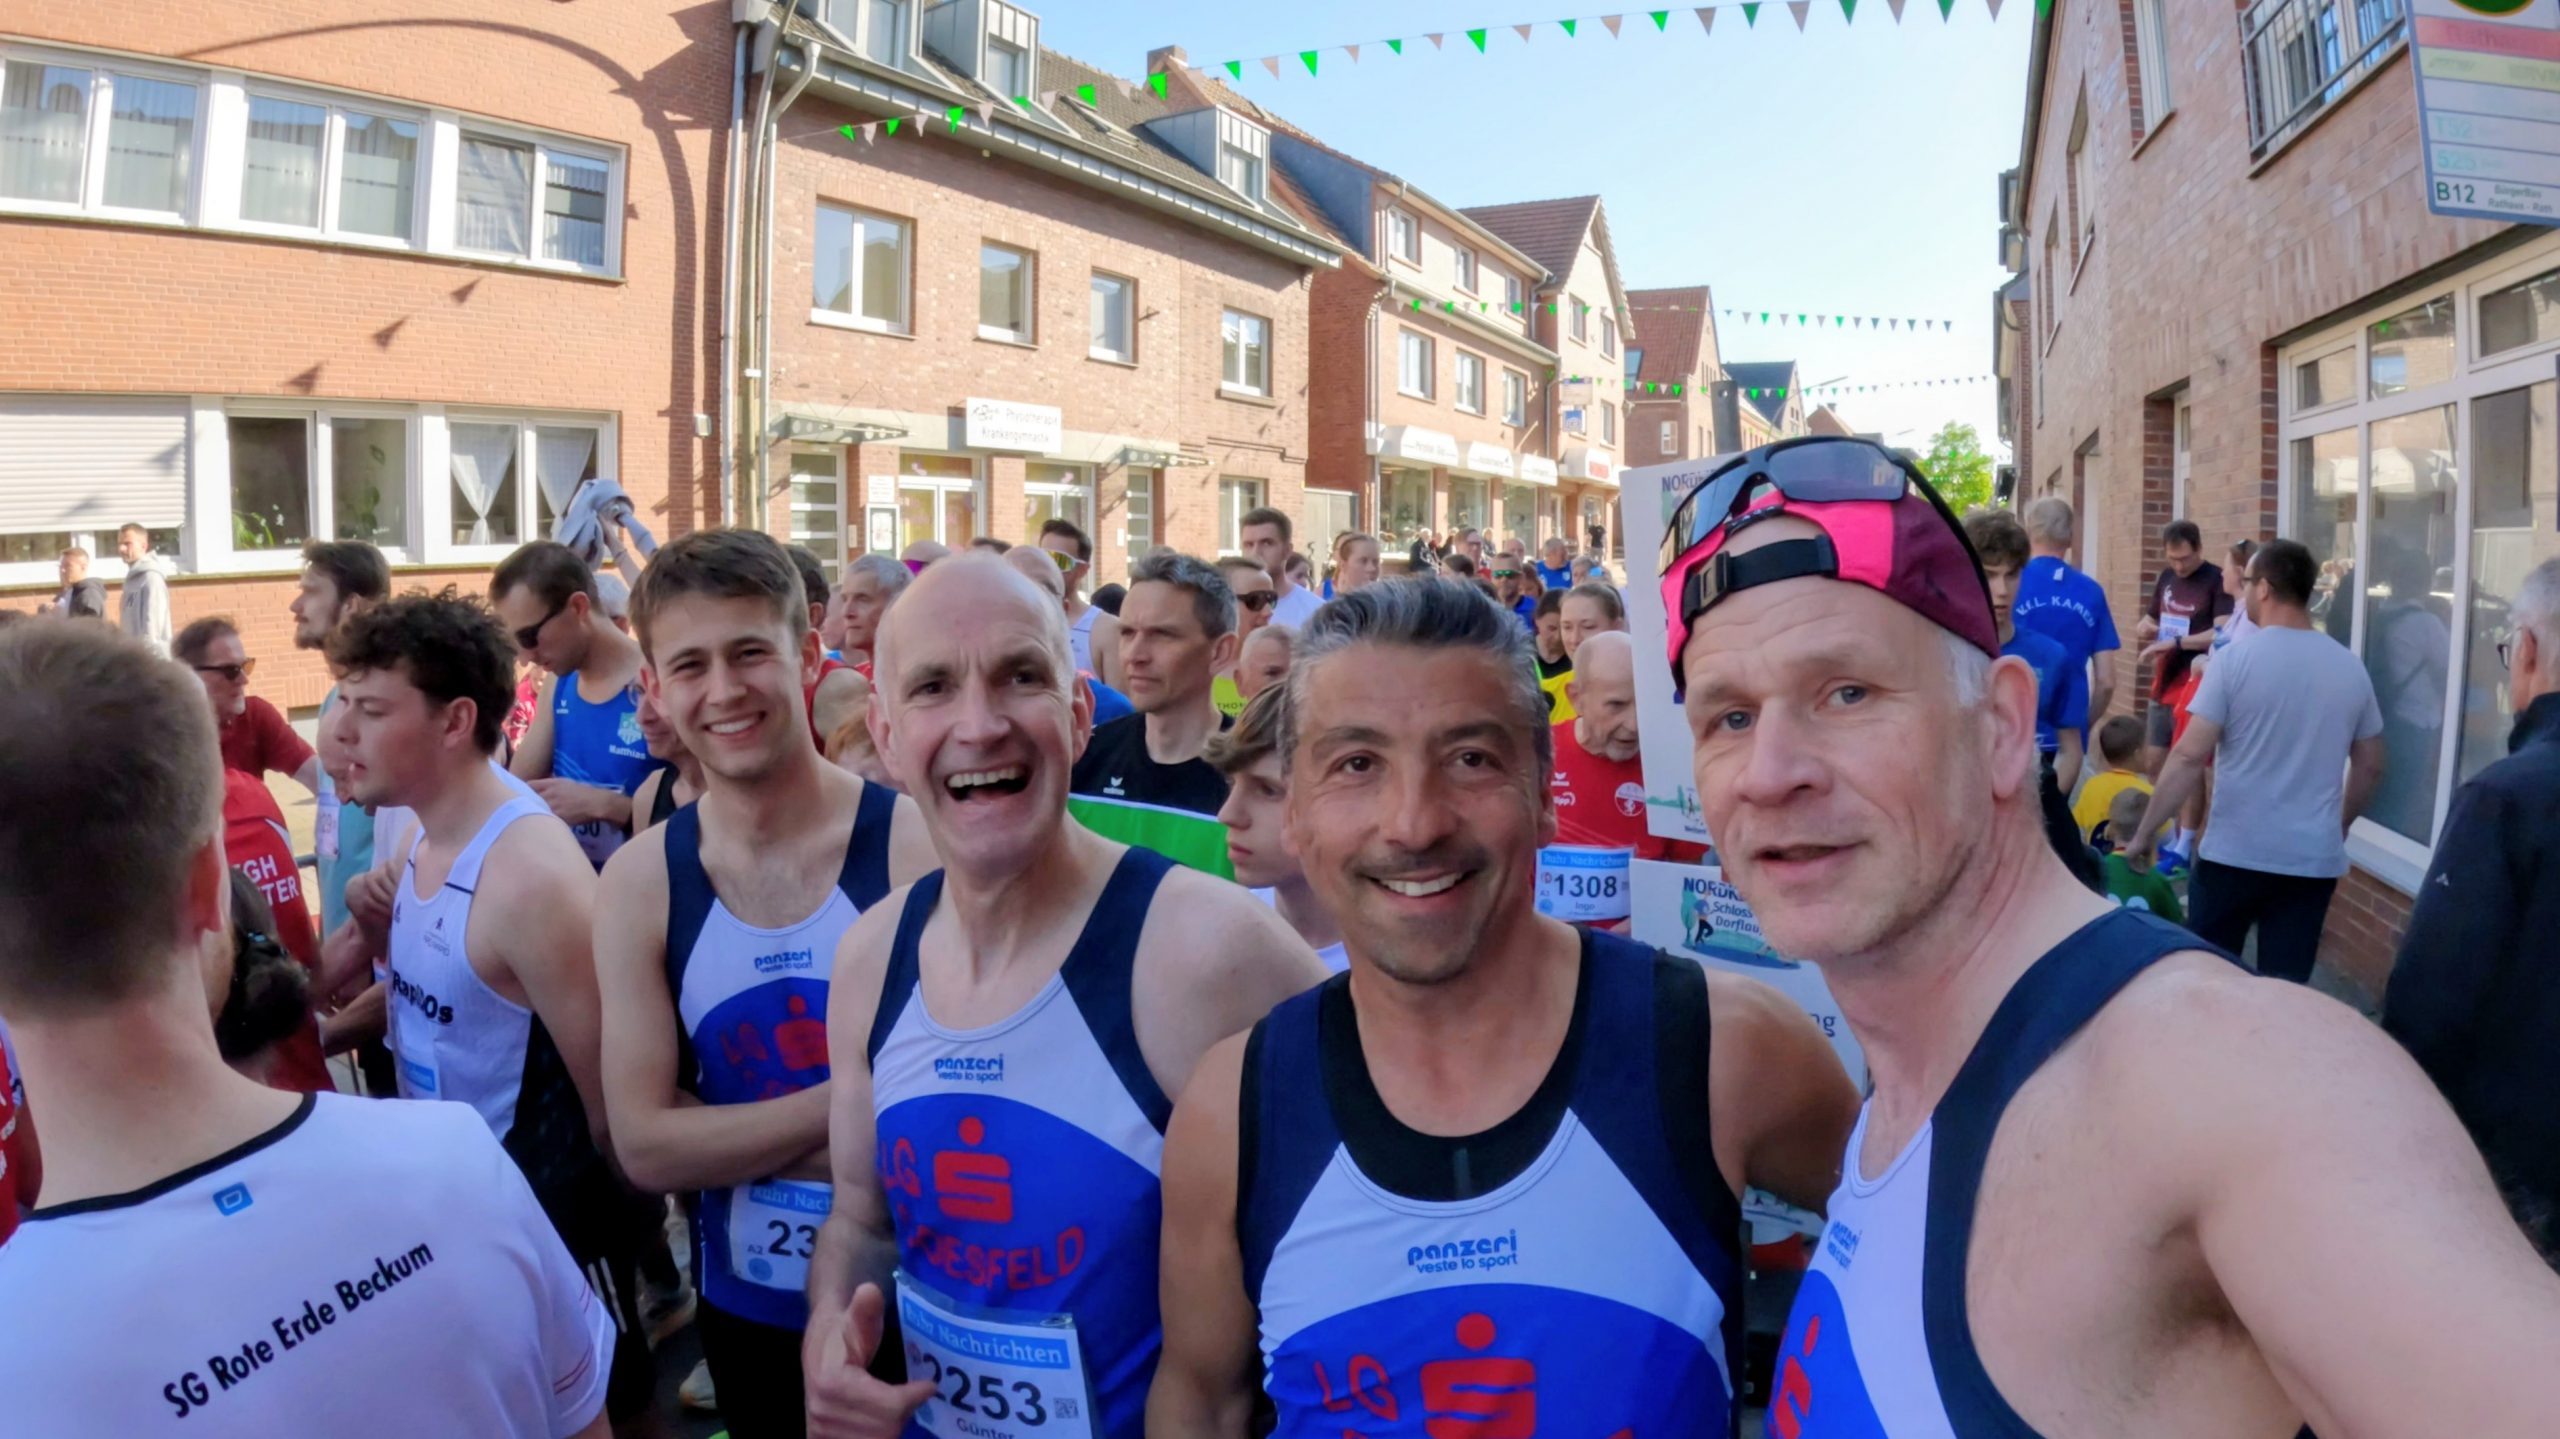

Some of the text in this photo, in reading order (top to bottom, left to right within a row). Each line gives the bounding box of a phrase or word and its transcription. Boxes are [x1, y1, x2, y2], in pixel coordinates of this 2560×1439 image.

[2436, 181, 2475, 204] B12
[2051, 596, 2095, 628] KAMEN
[608, 744, 647, 760] Matthias
[233, 854, 278, 883] GH
[259, 876, 299, 906] TER
[1554, 873, 1617, 898] 1308
[1575, 902, 1596, 911] Ingo
[1715, 915, 1764, 936] Dorflau
[754, 947, 812, 969] panzeri
[934, 1053, 1004, 1073] panzeri
[938, 1070, 1004, 1083] veste lo sport
[1407, 1229, 1518, 1266] panzeri
[1417, 1252, 1518, 1274] veste lo sport
[163, 1243, 434, 1419] SG Rote Erde Beckum
[937, 1322, 1064, 1365] Nachrichten
[922, 1352, 1048, 1428] 2253
[1313, 1354, 1398, 1422] LG
[956, 1417, 1015, 1439] Günter
